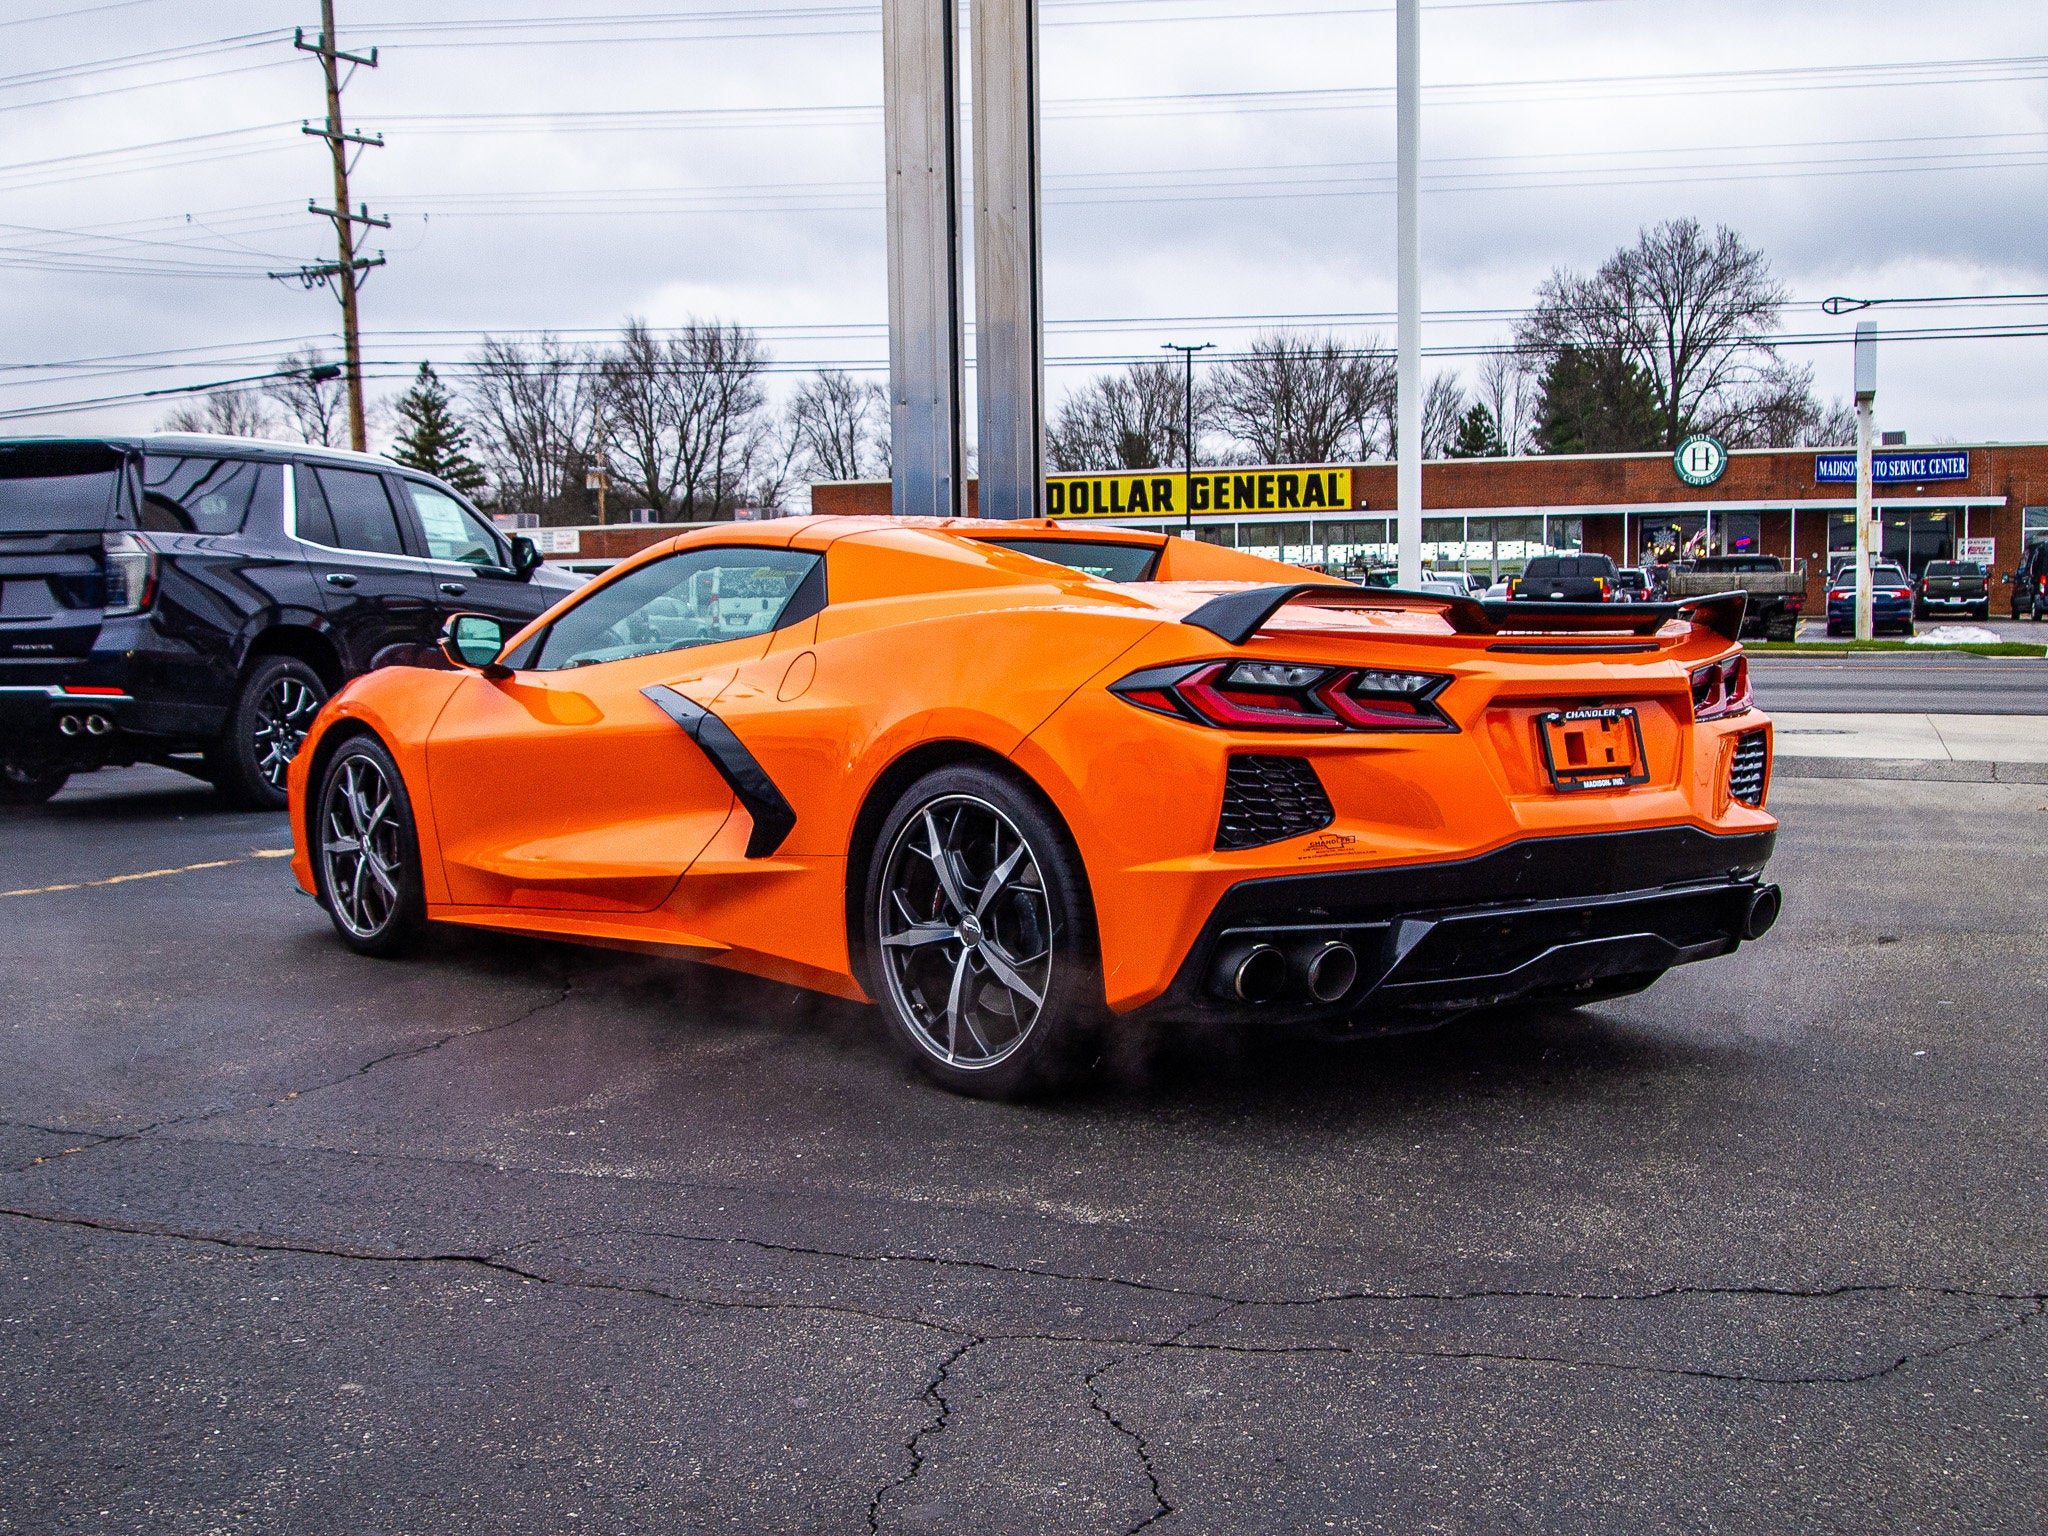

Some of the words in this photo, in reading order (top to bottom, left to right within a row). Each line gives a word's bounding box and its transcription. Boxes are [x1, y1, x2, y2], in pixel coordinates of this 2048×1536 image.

[1690, 433, 1711, 442] HOS
[1872, 460, 1888, 476] UTO
[1889, 459, 1927, 476] SERVICE
[1929, 457, 1965, 474] CENTER
[1683, 473, 1718, 485] COFFEE
[1046, 478, 1174, 514] DOLLAR
[1190, 473, 1345, 510] GENERAL
[1566, 709, 1615, 719] CHANDLER
